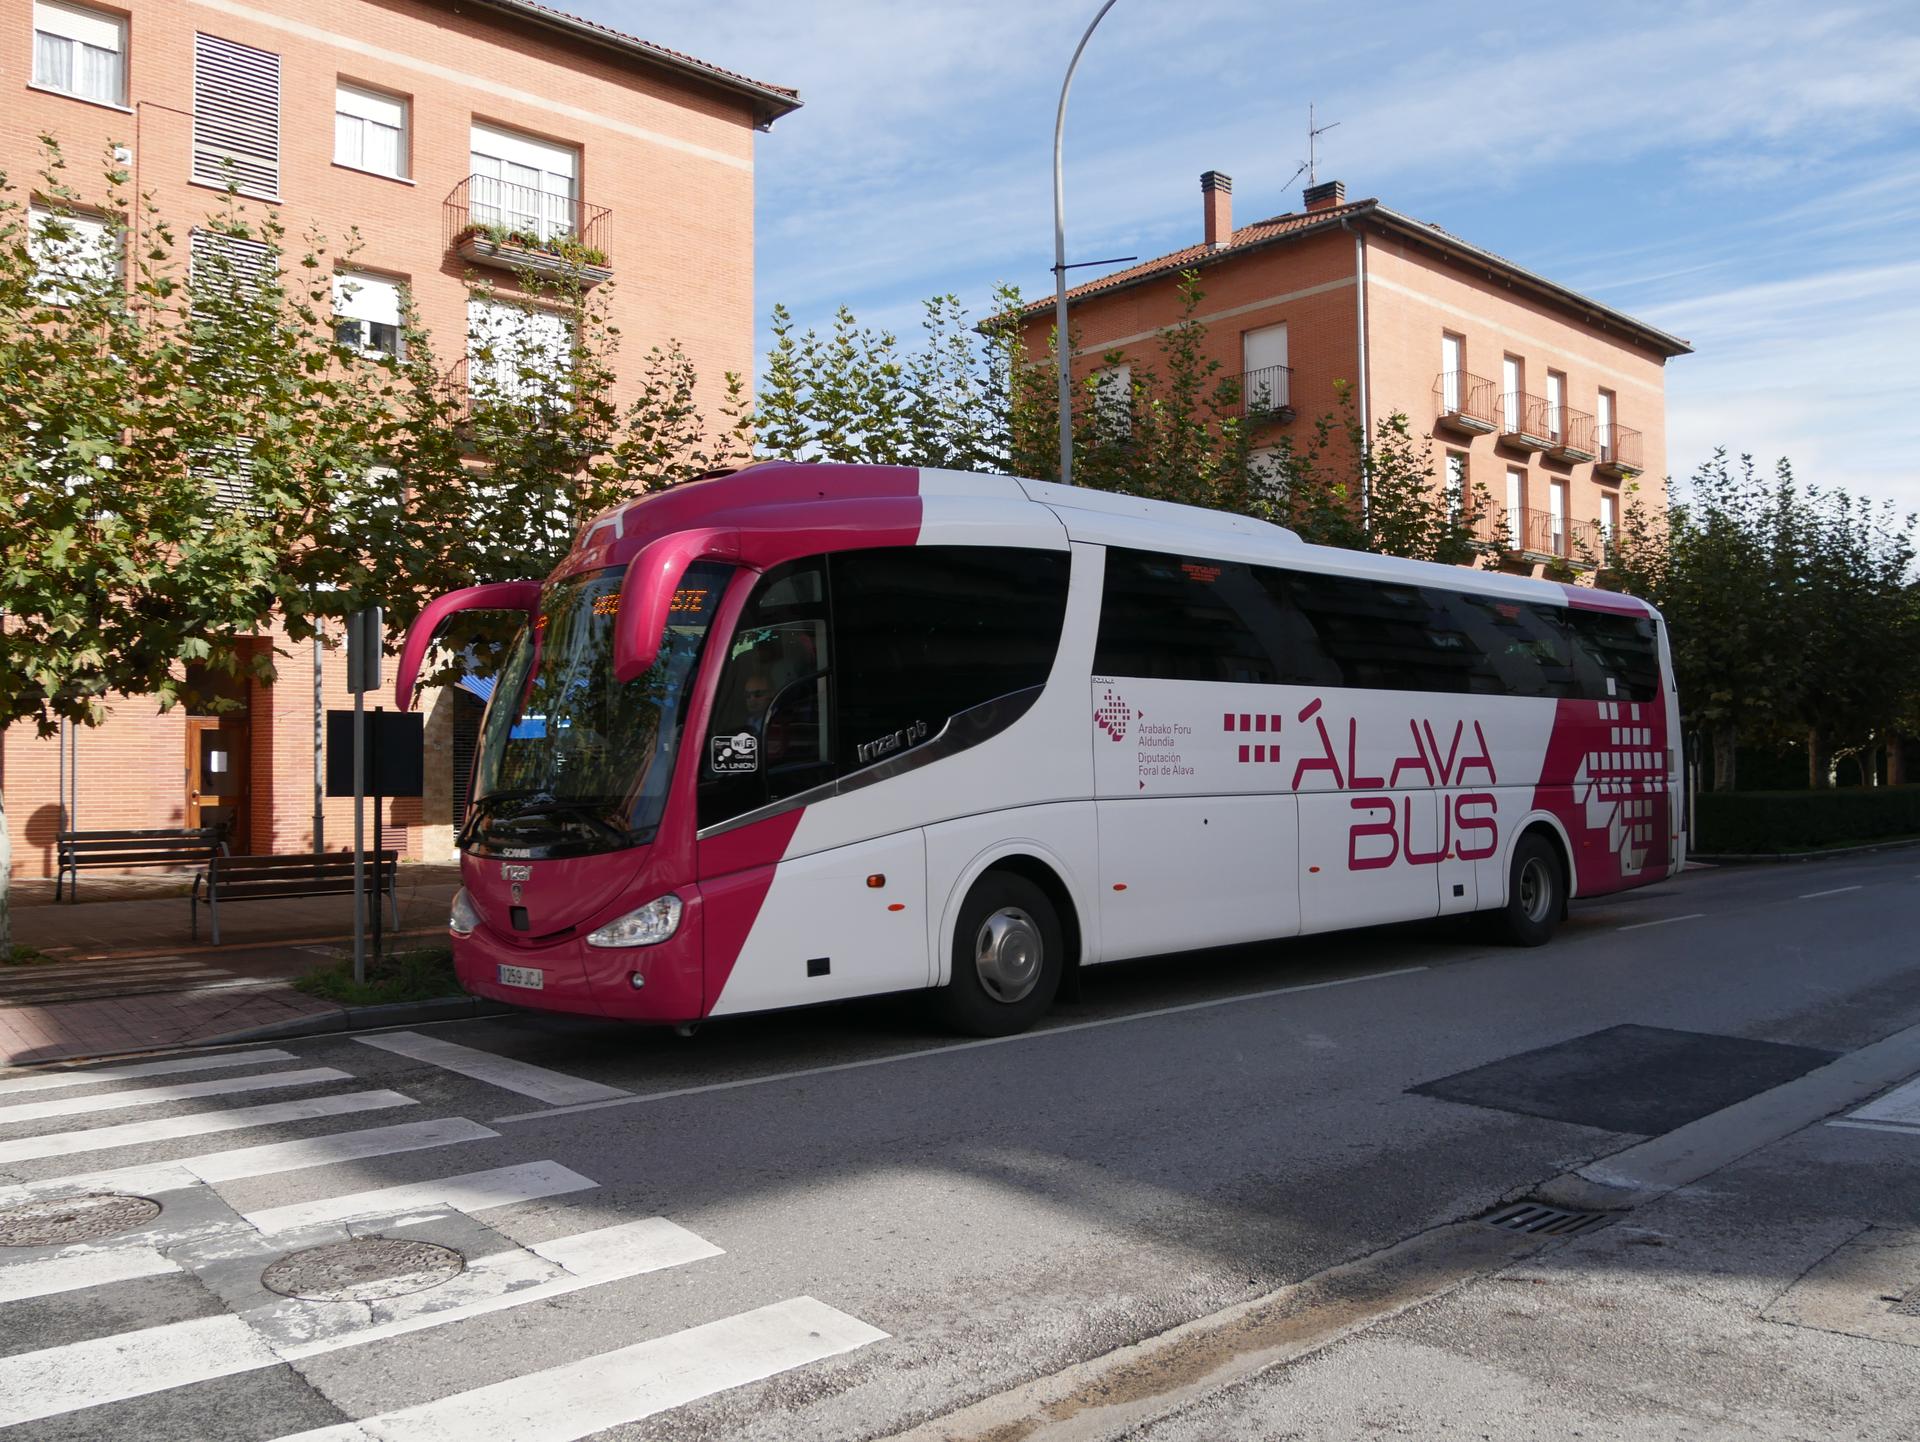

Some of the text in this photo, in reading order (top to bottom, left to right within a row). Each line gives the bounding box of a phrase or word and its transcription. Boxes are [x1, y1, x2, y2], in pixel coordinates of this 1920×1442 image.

[1138, 723, 1192, 735] Arabako Foru
[1138, 736, 1175, 747] Aldundia
[1292, 698, 1497, 790] ÁLAVA
[1138, 751, 1181, 764] Diputación
[1138, 764, 1159, 776] Foral
[1160, 764, 1171, 776] de
[1348, 793, 1498, 871] BUS
